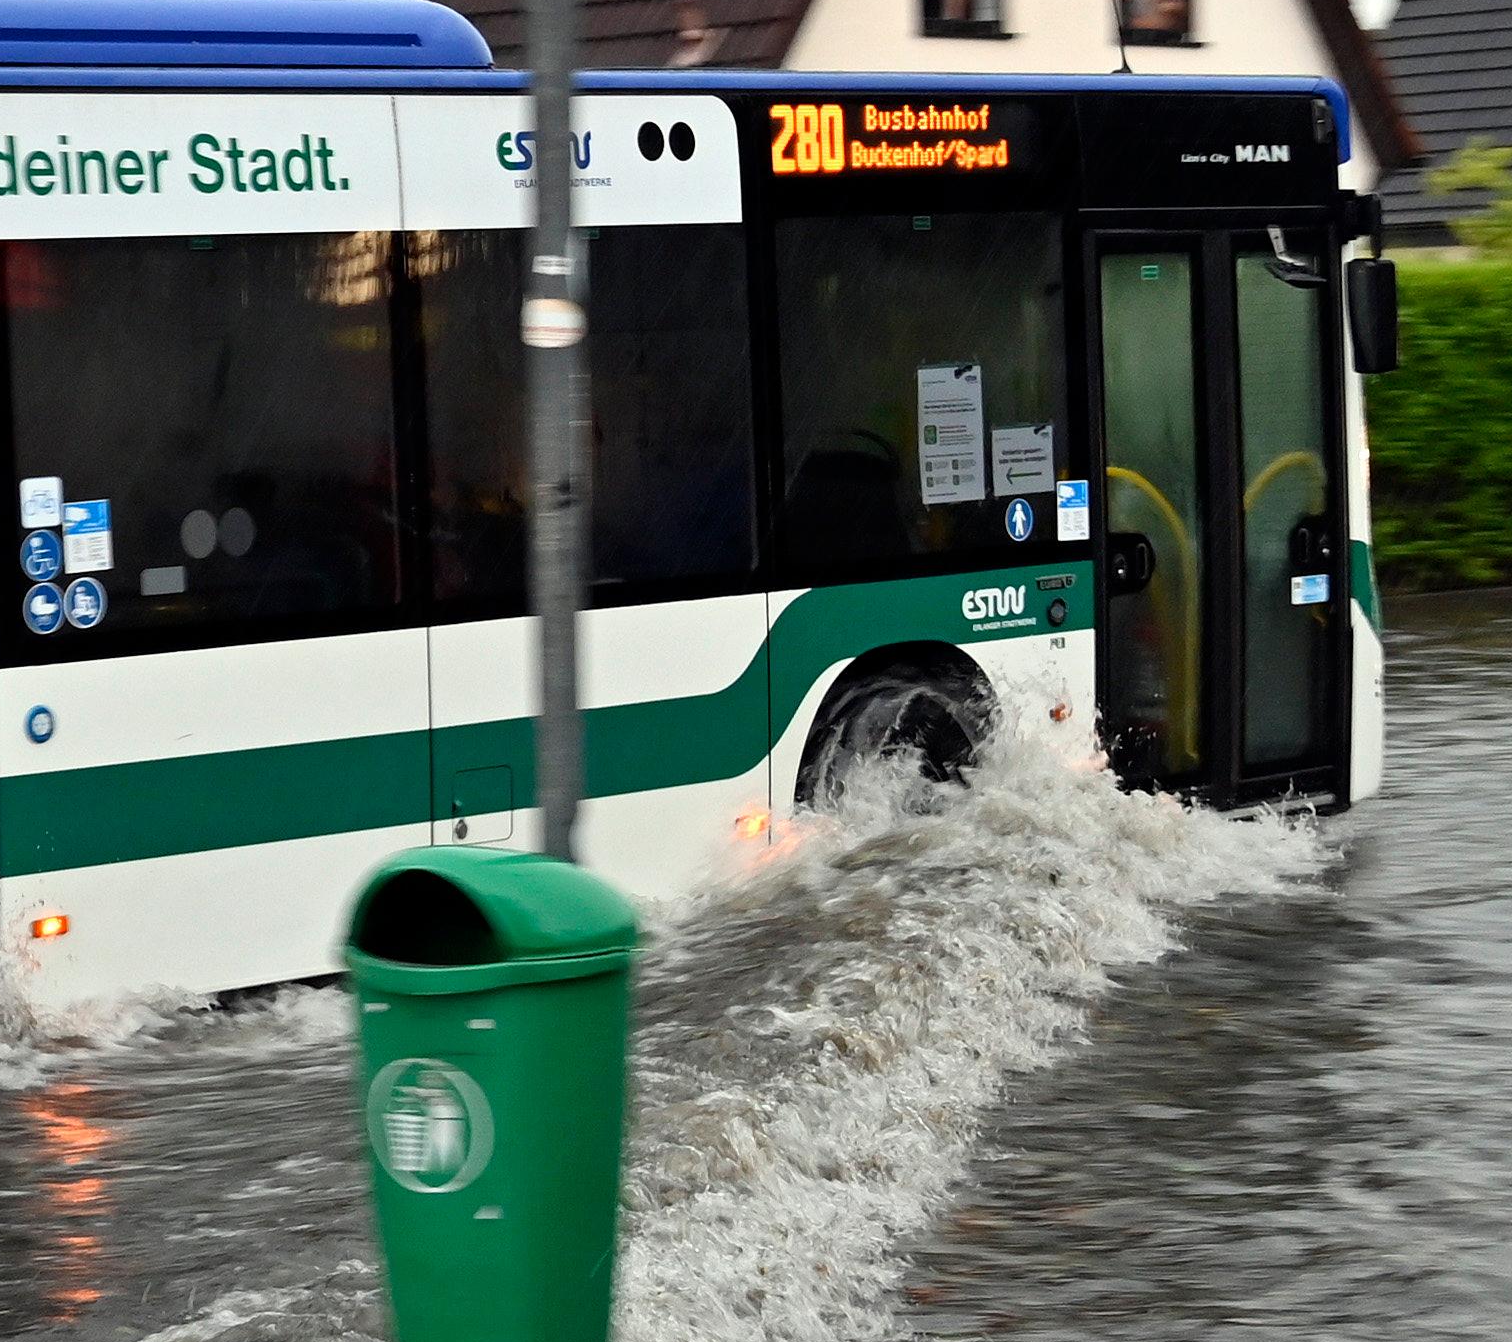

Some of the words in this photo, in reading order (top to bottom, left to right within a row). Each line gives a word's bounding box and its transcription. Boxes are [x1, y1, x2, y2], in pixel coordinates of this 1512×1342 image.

[769, 105, 844, 172] 280
[864, 104, 990, 130] Busbahnhof
[187, 133, 350, 193] Stadt.
[1235, 145, 1290, 162] MAN
